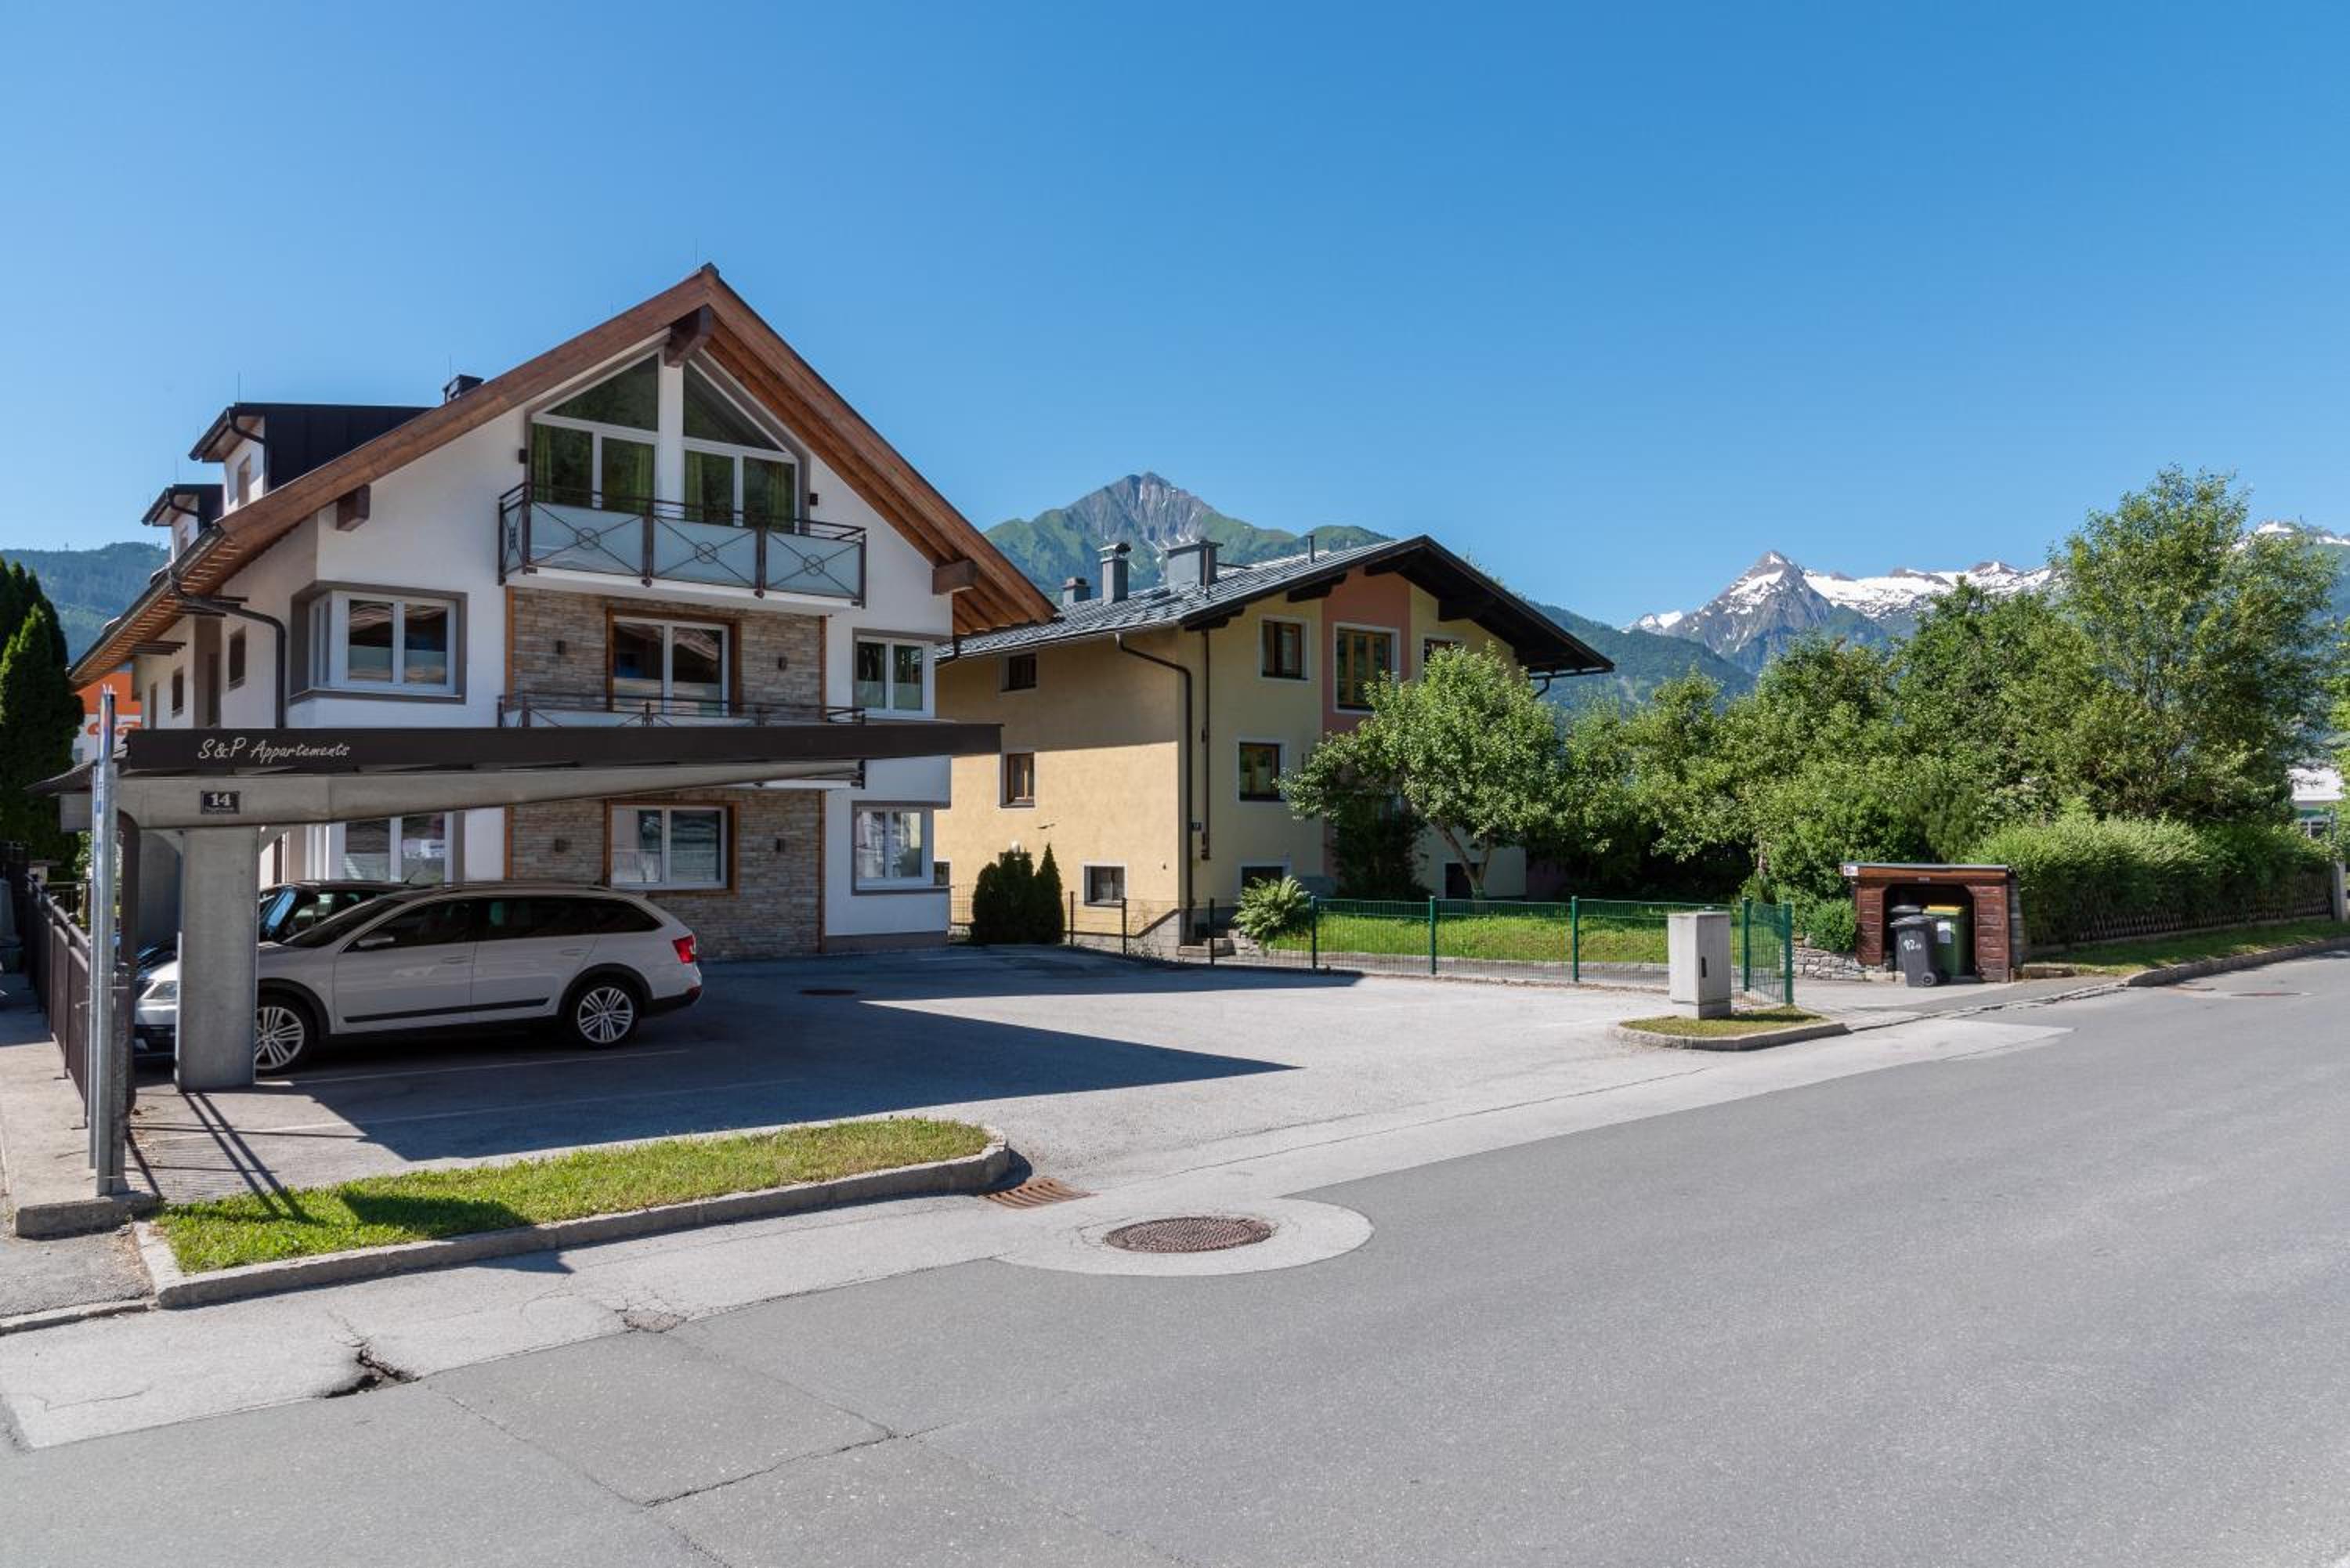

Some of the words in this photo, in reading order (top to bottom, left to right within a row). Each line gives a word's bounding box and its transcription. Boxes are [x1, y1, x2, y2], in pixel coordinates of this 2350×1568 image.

[197, 737, 247, 759] S&P
[250, 739, 350, 764] Appartements
[210, 793, 230, 806] 14
